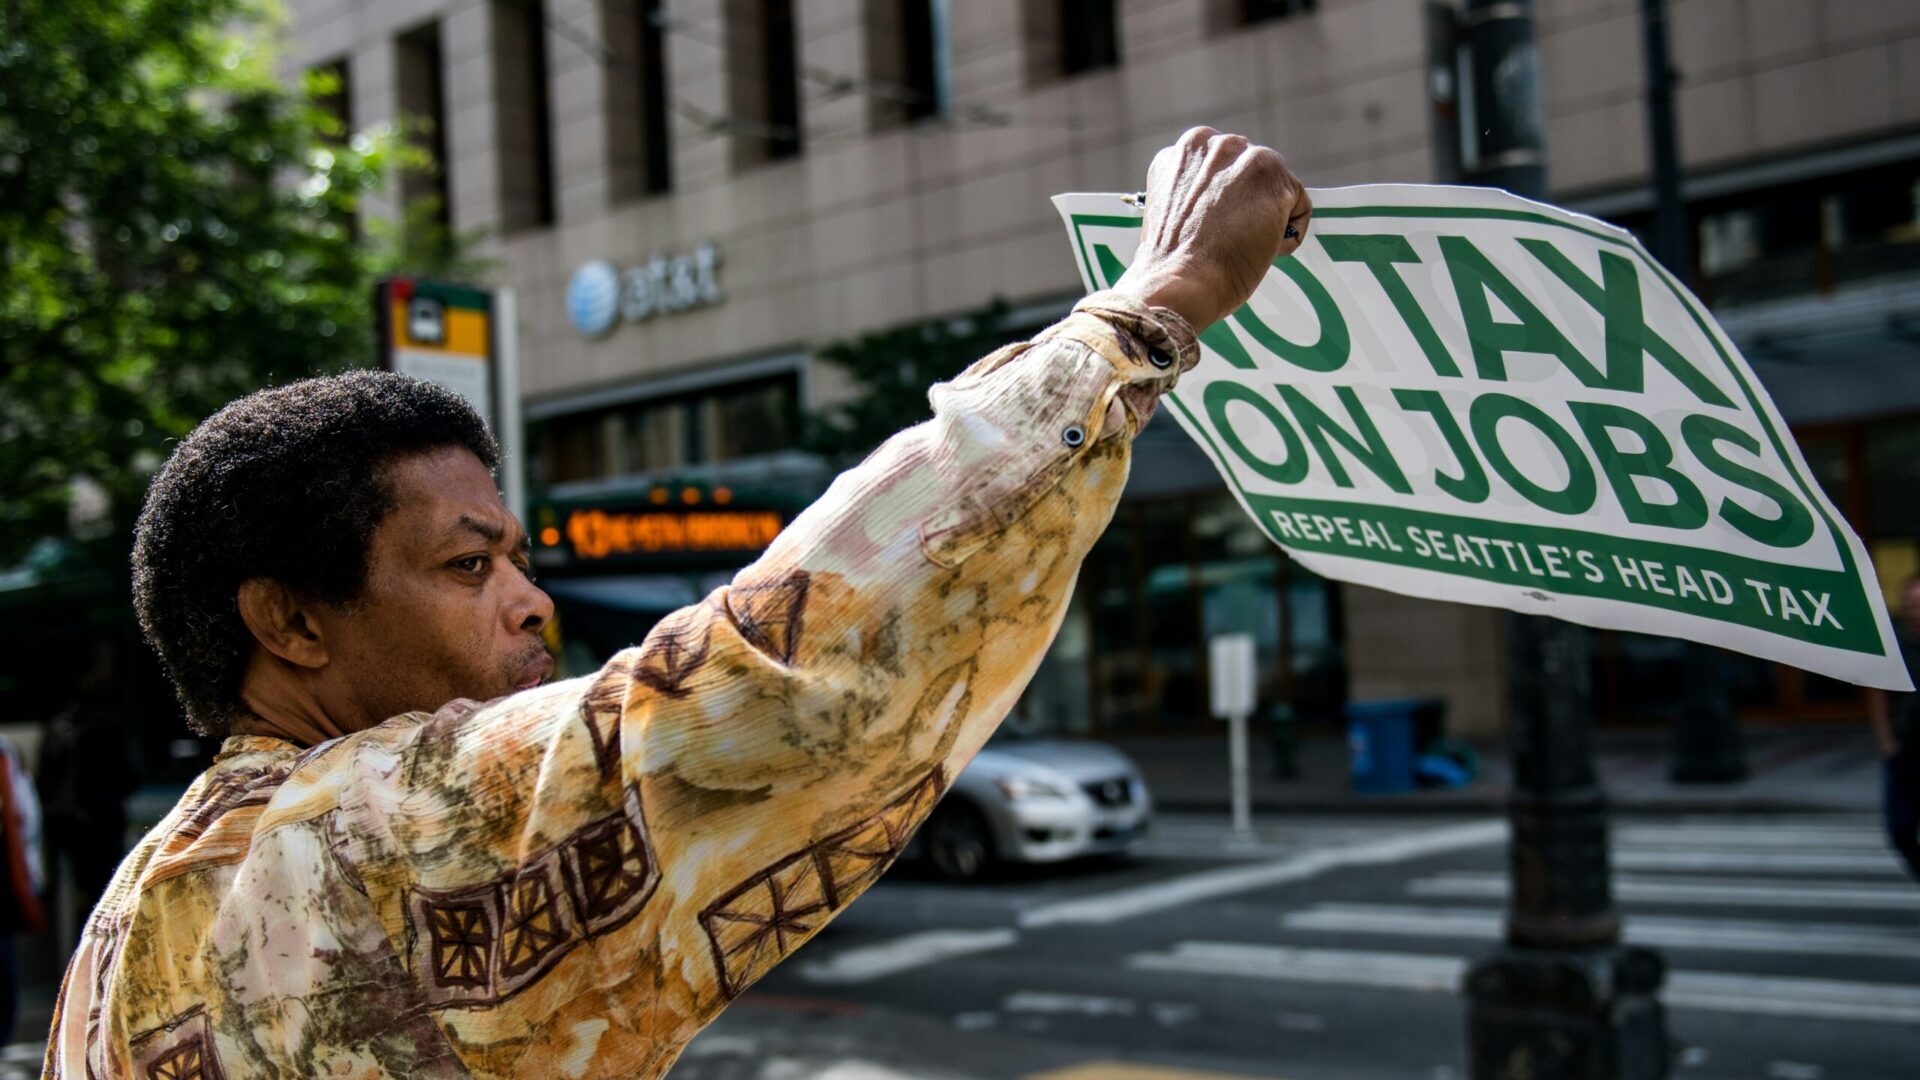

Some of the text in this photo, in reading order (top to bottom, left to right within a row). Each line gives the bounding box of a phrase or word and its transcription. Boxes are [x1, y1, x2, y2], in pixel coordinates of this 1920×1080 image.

[1315, 234, 1741, 411] TAX
[1203, 380, 1815, 549] ON JOBS
[1270, 509, 1845, 631] REPEAL SEATTLE'S HEAD TAX
